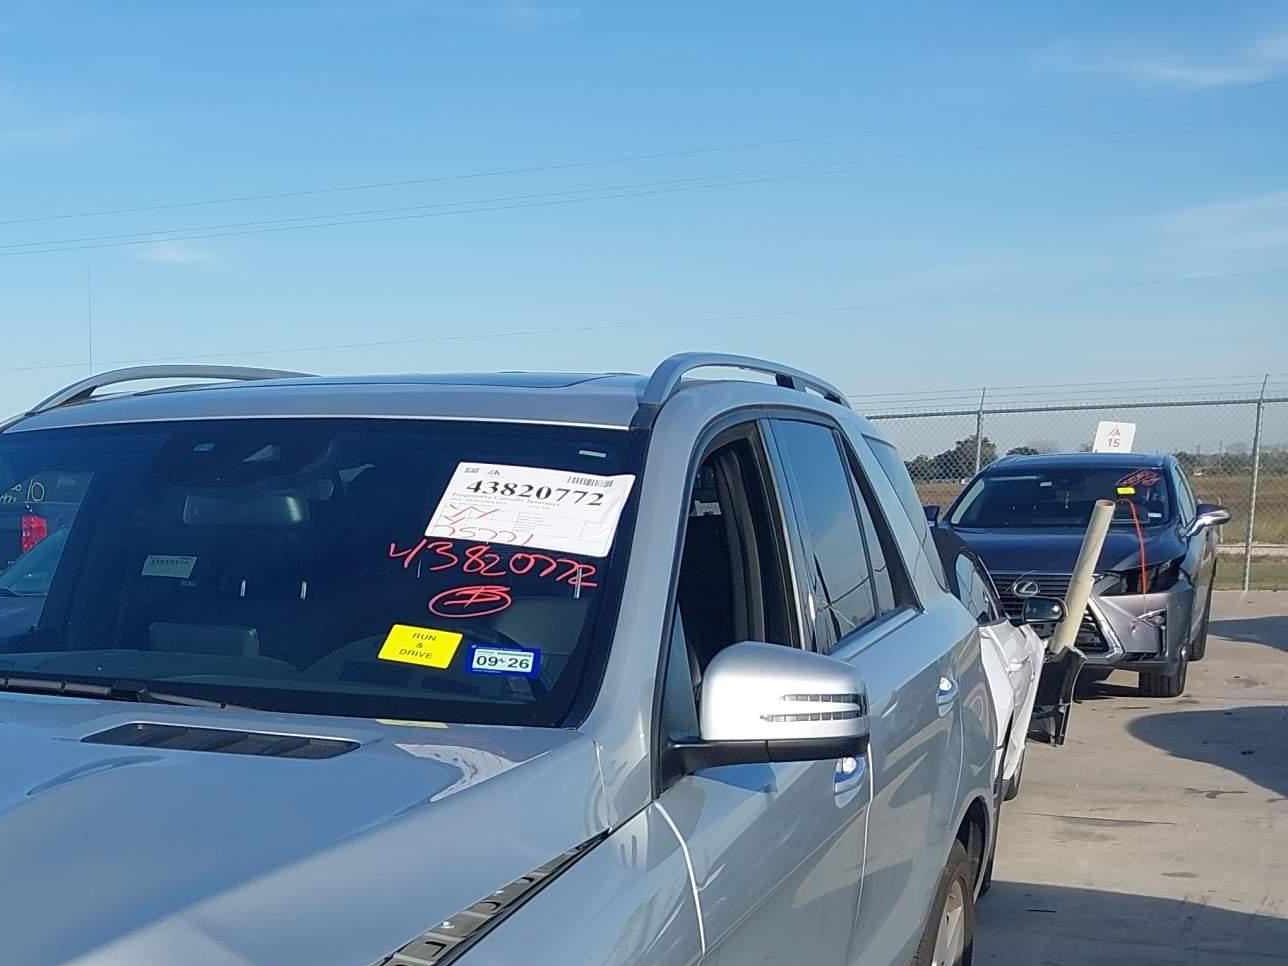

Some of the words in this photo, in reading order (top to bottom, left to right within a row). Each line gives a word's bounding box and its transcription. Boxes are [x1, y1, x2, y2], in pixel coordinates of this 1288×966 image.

[1107, 438, 1121, 448] 15
[465, 479, 605, 507] 43820772
[389, 538, 598, 587] 43820772
[412, 632, 437, 641] RUN
[399, 648, 433, 660] DRIVE
[476, 655, 498, 667] 09
[508, 657, 530, 669] 26
